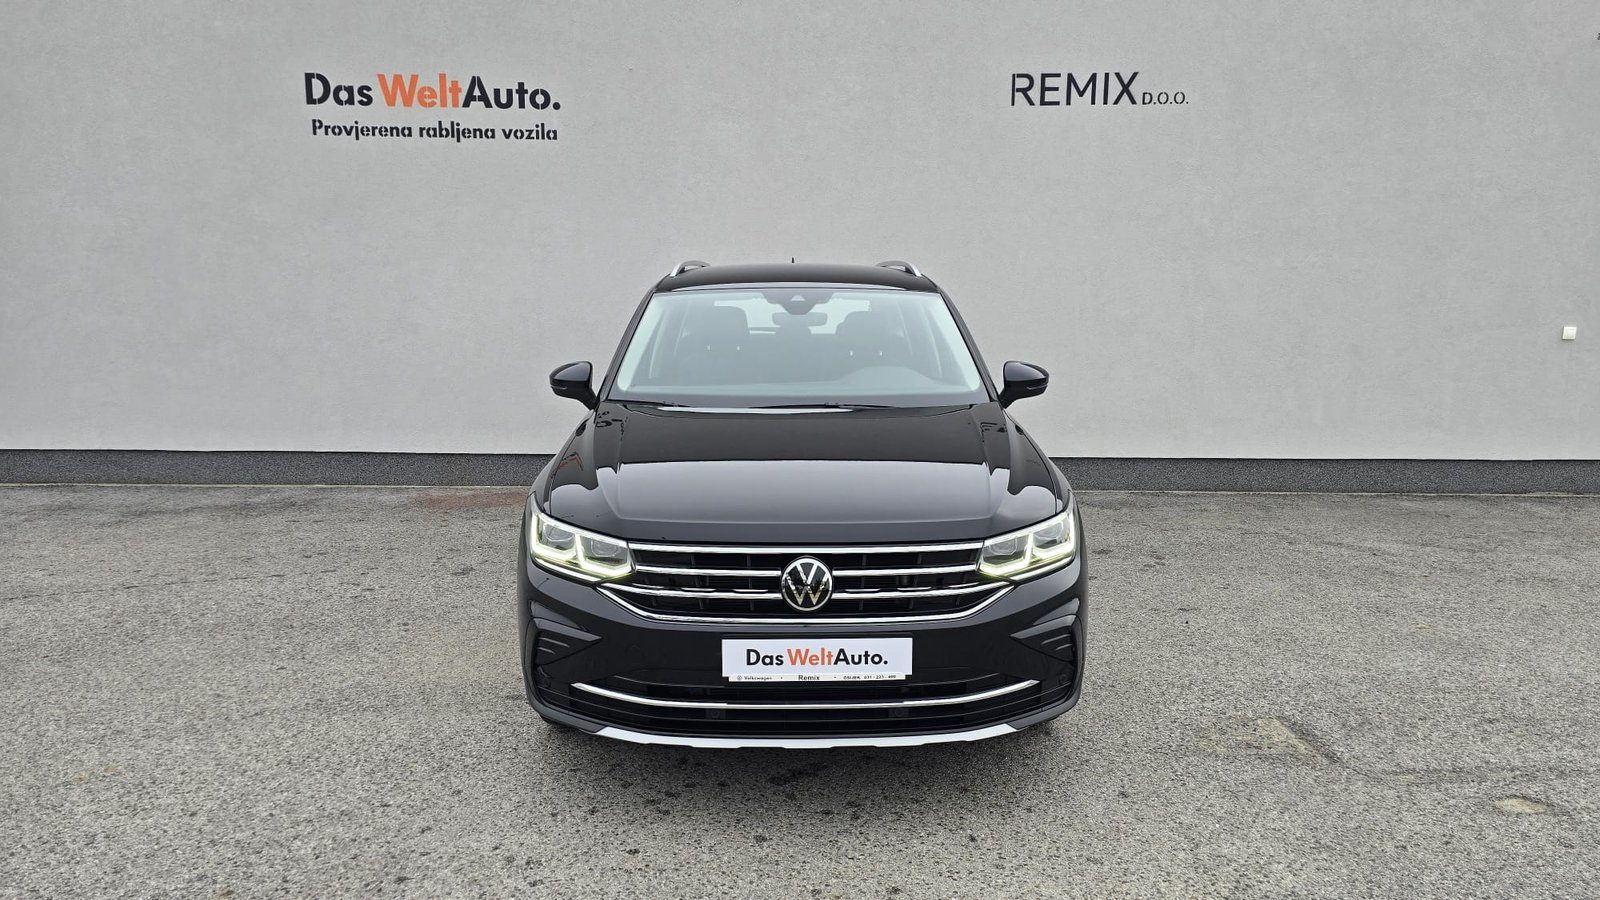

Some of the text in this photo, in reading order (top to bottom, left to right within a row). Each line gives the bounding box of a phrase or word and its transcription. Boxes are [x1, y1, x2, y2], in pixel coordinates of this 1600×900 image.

[305, 73, 560, 110] Das WeltAuto.
[1011, 72, 1188, 106] REMIX D.O.O.
[312, 119, 557, 143] Provjerena rabljena vozila
[747, 648, 888, 666] Das WeltAuto.
